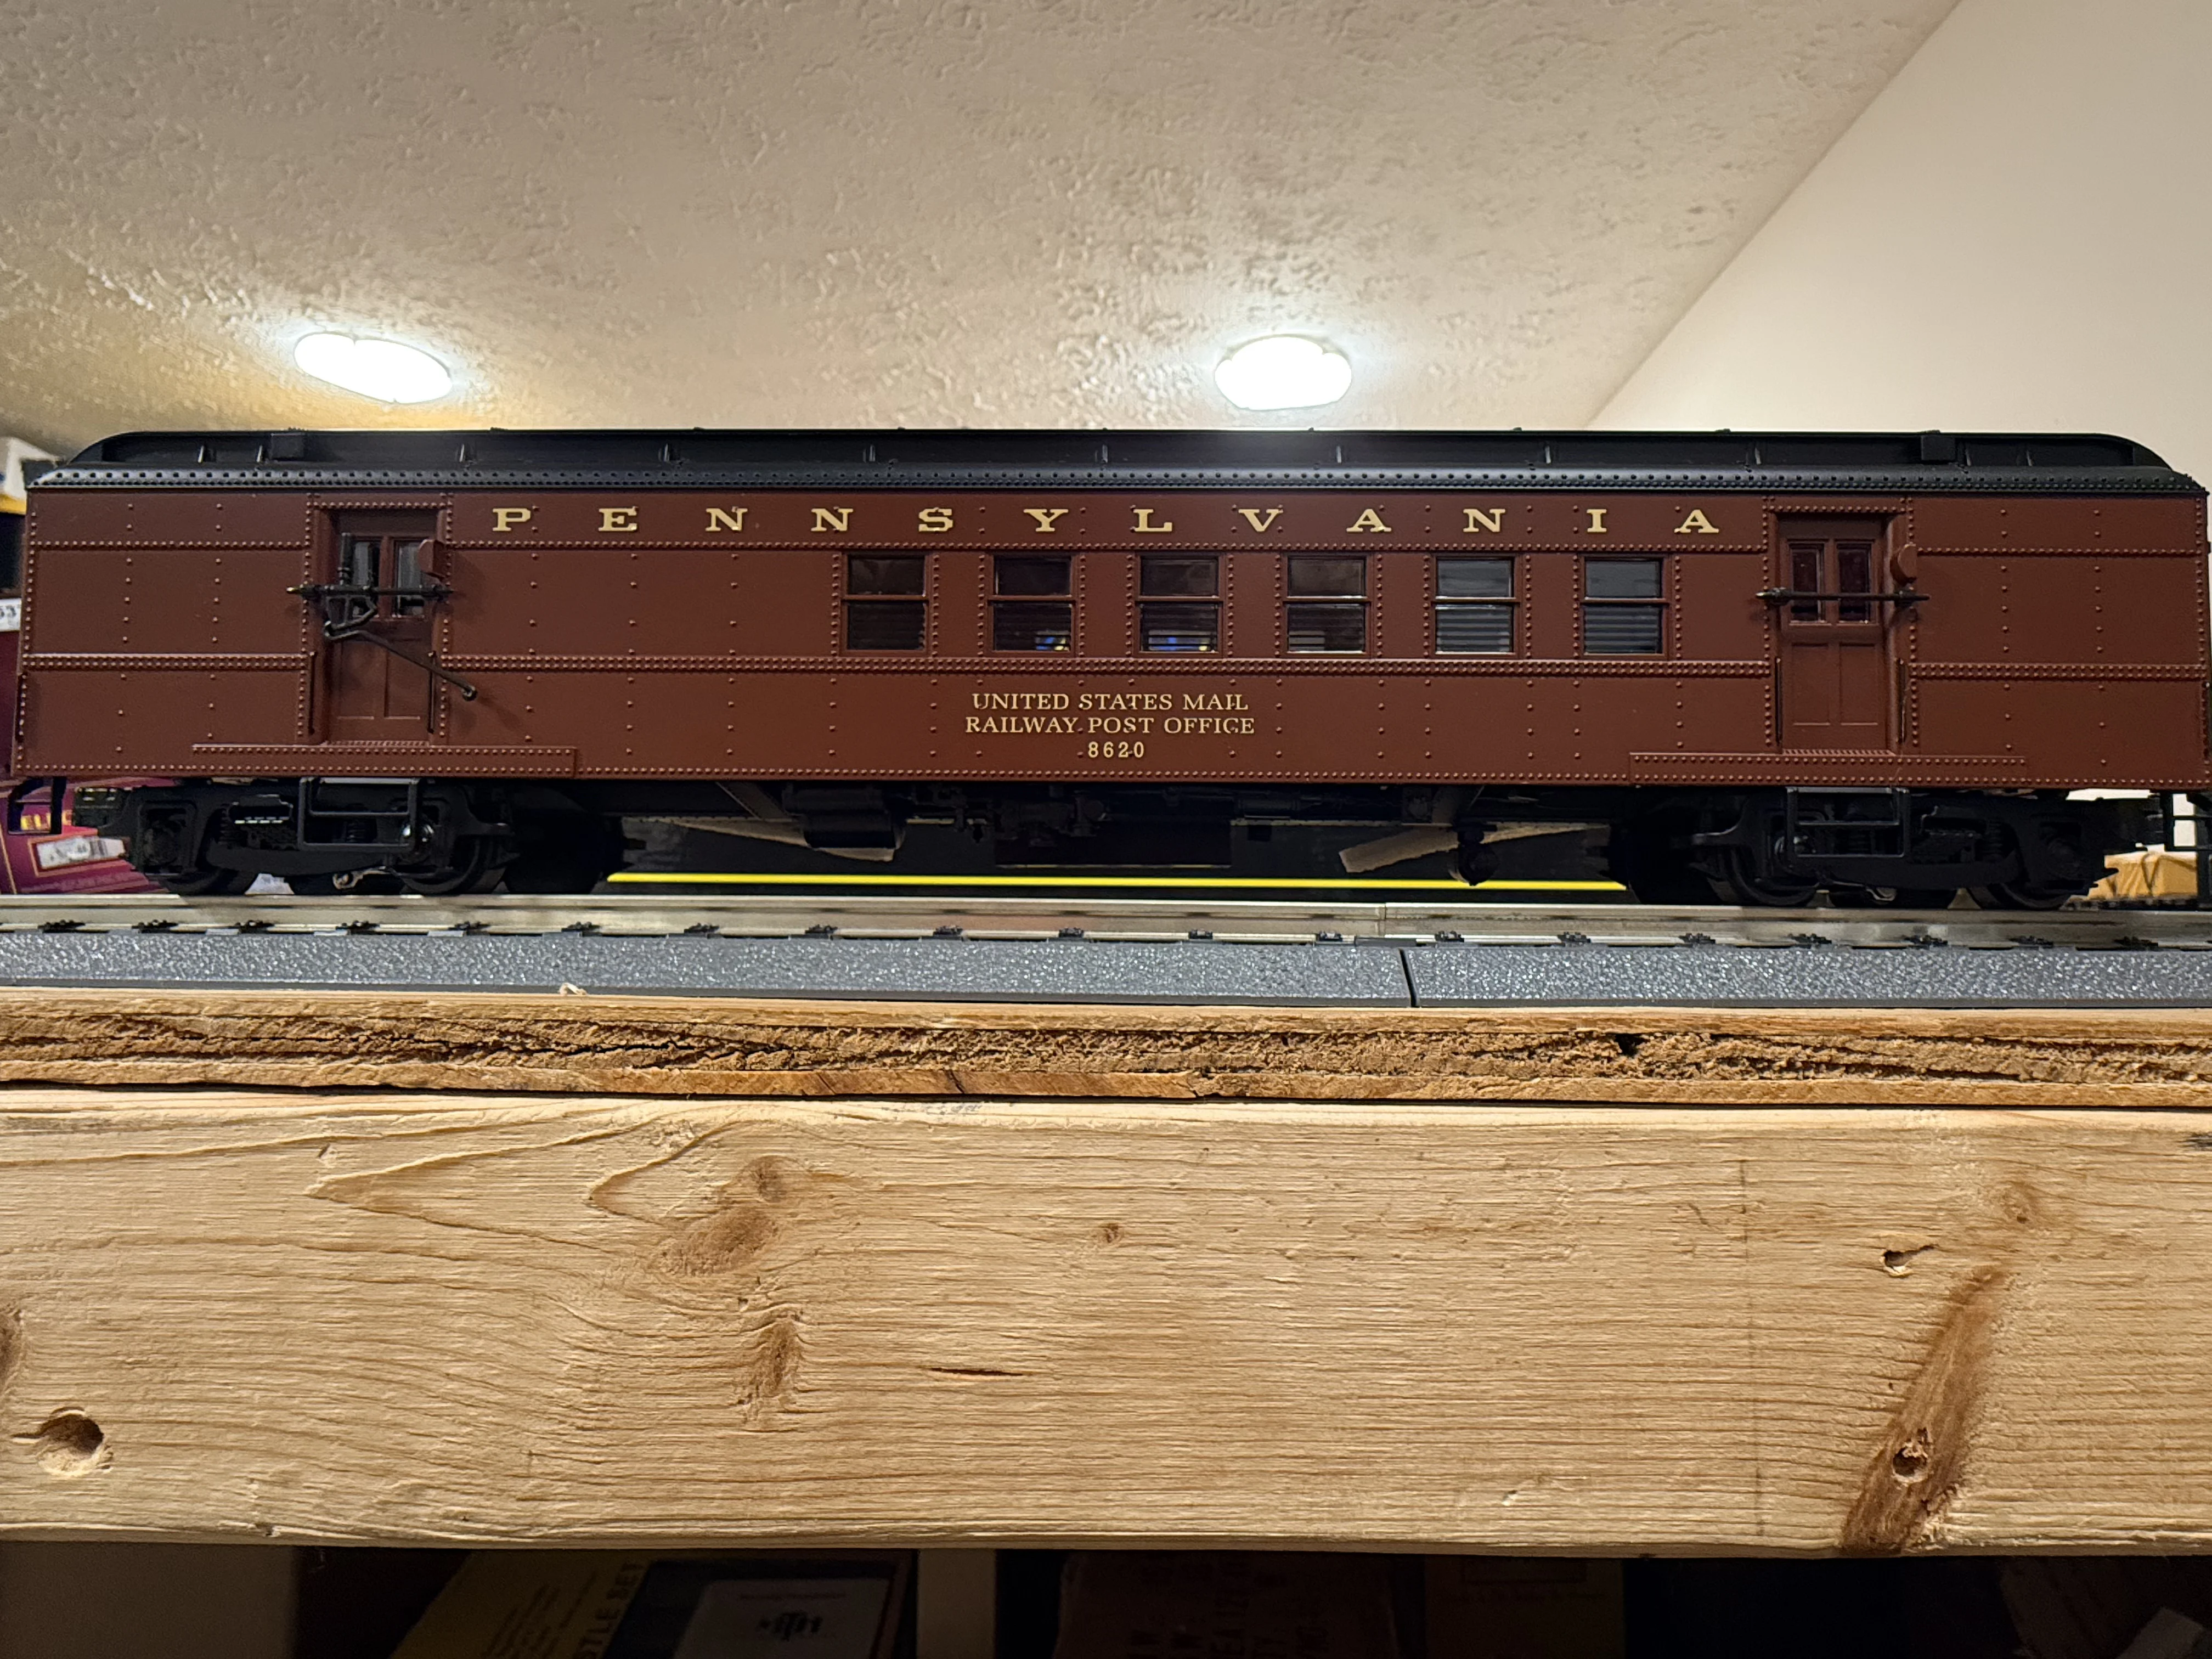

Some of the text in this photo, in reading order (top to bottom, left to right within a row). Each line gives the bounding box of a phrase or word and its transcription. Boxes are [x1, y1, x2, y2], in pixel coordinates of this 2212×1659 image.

[493, 506, 1719, 533] PENNSYLVANIA
[973, 693, 1248, 710] UNITED STATES MAIL
[966, 716, 1254, 733] RAILWAY POST OFFICE
[1088, 741, 1144, 758] 8620
